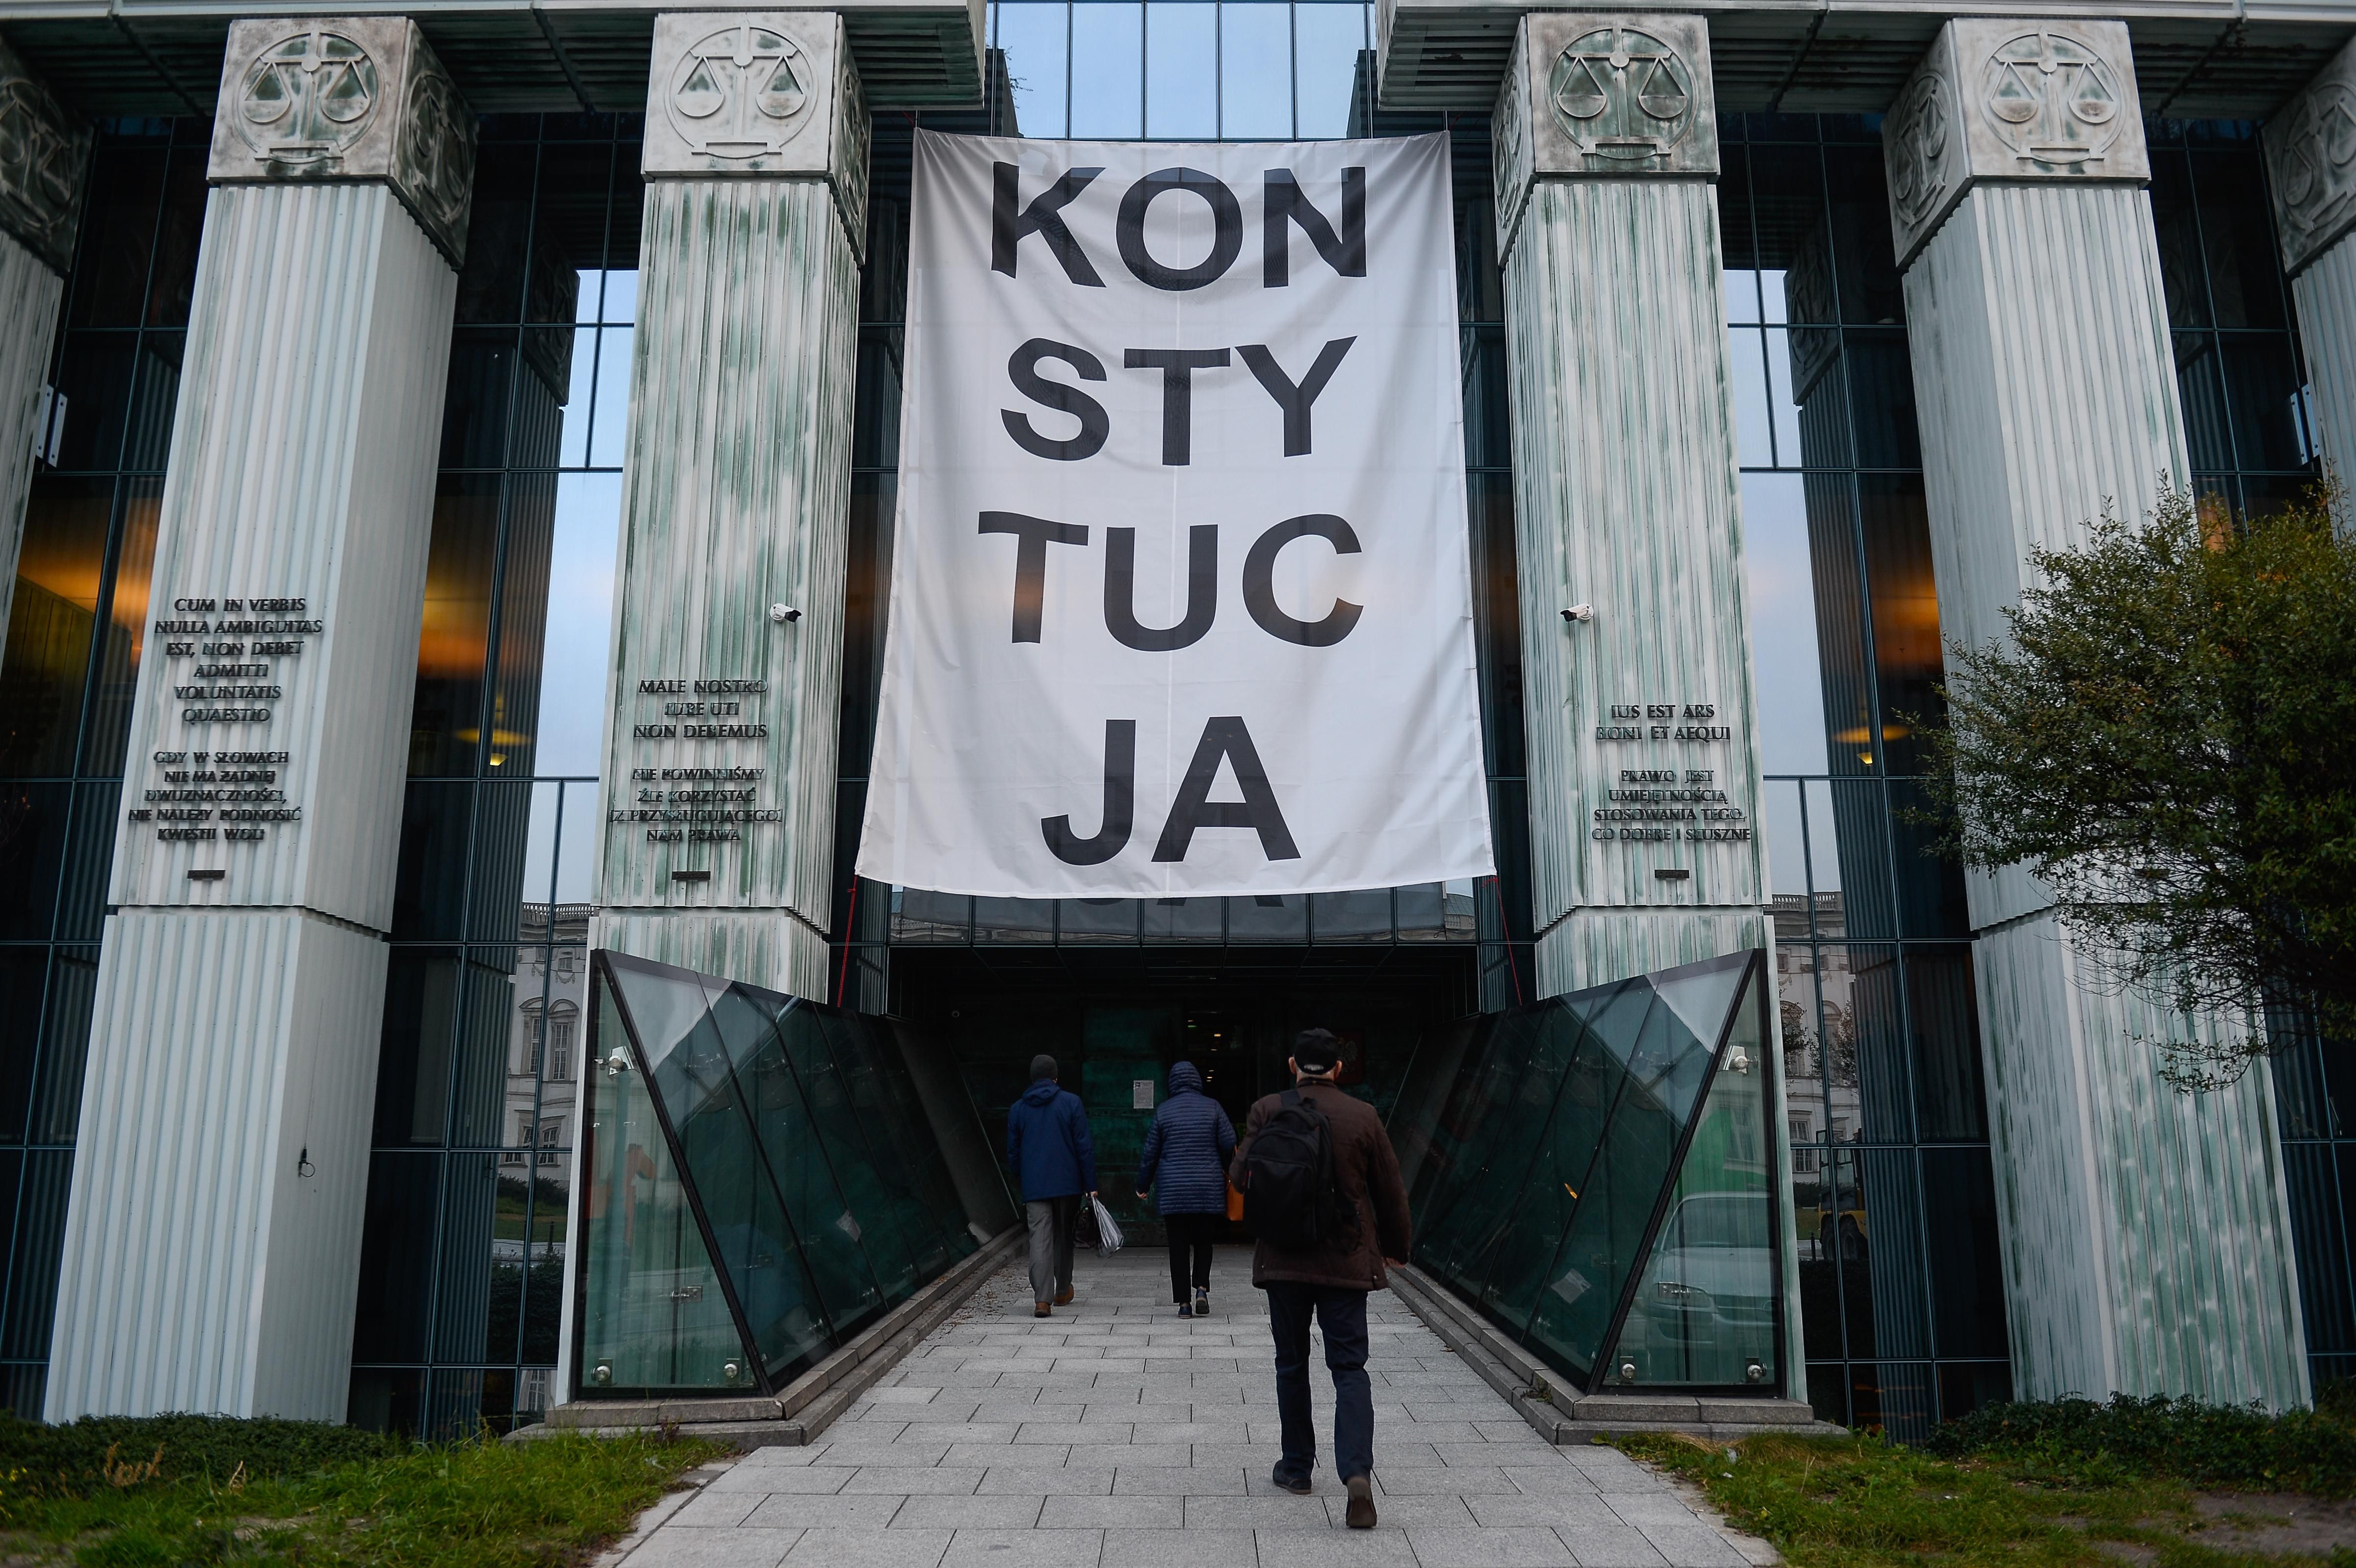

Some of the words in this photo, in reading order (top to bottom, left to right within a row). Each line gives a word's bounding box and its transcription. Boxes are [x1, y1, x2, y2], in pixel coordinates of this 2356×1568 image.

[989, 160, 1367, 292] KON
[1000, 335, 1358, 467] STY
[977, 510, 1365, 652] TUC
[175, 598, 215, 611] CUM
[224, 599, 243, 611] IN
[249, 598, 305, 611] VERBIS
[155, 621, 209, 633] NULLA
[215, 620, 322, 633] AMBIGUITAS
[166, 643, 195, 658] EST,
[202, 643, 244, 655] NON
[251, 641, 304, 655] DEBET
[194, 665, 268, 677] ADMITTI
[175, 686, 281, 698] VOLUNTATIS
[639, 680, 686, 693] MALE
[694, 680, 768, 693] NOSTRO
[664, 702, 704, 715] IURE
[710, 702, 739, 715] UTI
[1611, 705, 1640, 718] IUS
[1647, 705, 1676, 718] EST
[1683, 704, 1715, 718] ARS
[182, 709, 271, 724] QUAESTIO
[633, 725, 676, 737] NON
[683, 725, 767, 737] DEBEMUS
[1596, 727, 1642, 740] BONI
[1651, 726, 1670, 739] ET
[1674, 726, 1730, 742] AEQUI
[154, 752, 187, 763] GDY
[194, 752, 209, 763] W
[214, 752, 289, 763] SŁOWACH
[165, 771, 189, 782] NIE
[193, 771, 216, 782] MA
[632, 769, 657, 779] NIE
[662, 766, 764, 779] POWINNIŚMY
[1621, 771, 1676, 781] PRAWO
[1685, 770, 1714, 783] JEST
[669, 787, 756, 801] KORZYSTAĆ
[1040, 715, 1302, 867] JA
[128, 809, 152, 821] NIE
[220, 806, 301, 821] PODNOSIĆ
[1594, 809, 1697, 820] STOSOWANIA
[158, 828, 216, 840] KWESTII
[225, 828, 264, 840] WOLI
[647, 829, 682, 841] NAM
[688, 829, 741, 841] PRAWA
[1592, 828, 1615, 840] CO
[1620, 828, 1671, 840] DOBRE
[1677, 828, 1681, 840] I
